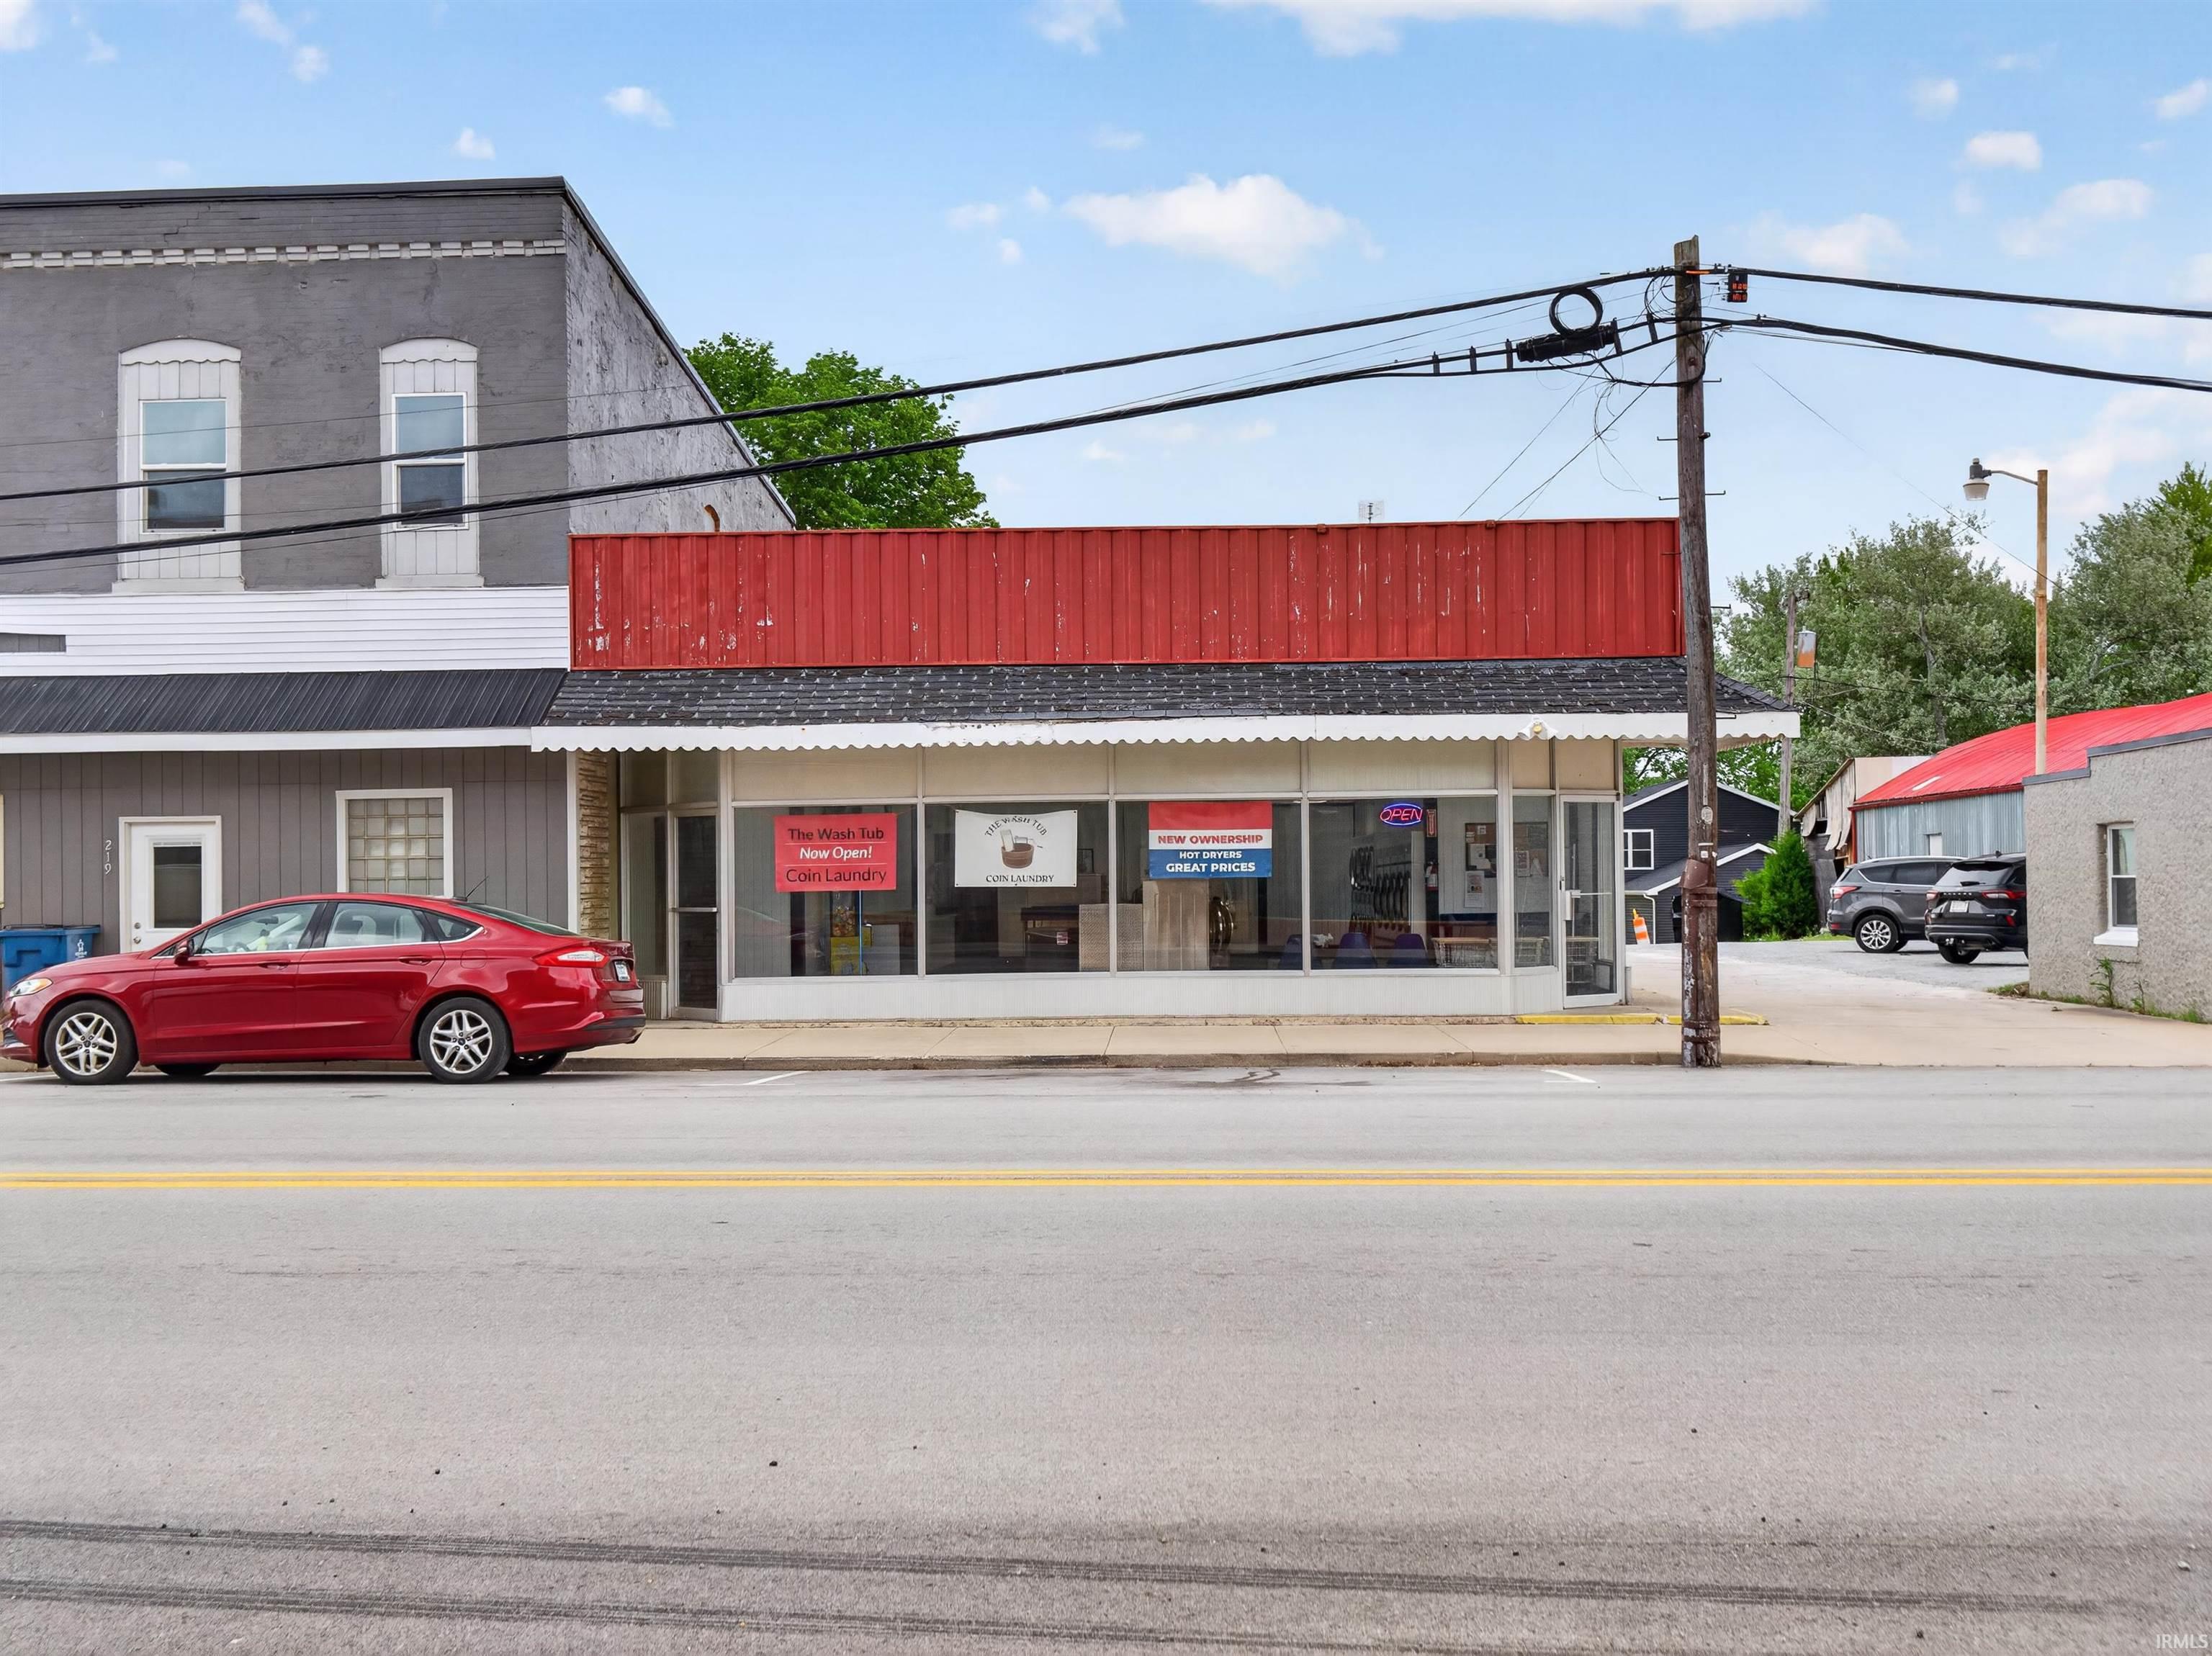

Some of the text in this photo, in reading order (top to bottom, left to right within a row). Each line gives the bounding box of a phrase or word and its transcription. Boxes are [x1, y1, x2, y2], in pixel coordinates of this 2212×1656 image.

[1380, 808, 1423, 822] OPEN
[984, 816, 1048, 837] THE WASH TUB
[788, 827, 884, 840] The Wash Tub
[1158, 834, 1264, 844] NEW OWNERSHIP
[799, 845, 873, 861] Now Open!
[1202, 850, 1242, 859] DRYERS
[1166, 862, 1256, 873] GREAT PRICES
[786, 867, 887, 884] Coin Laundry
